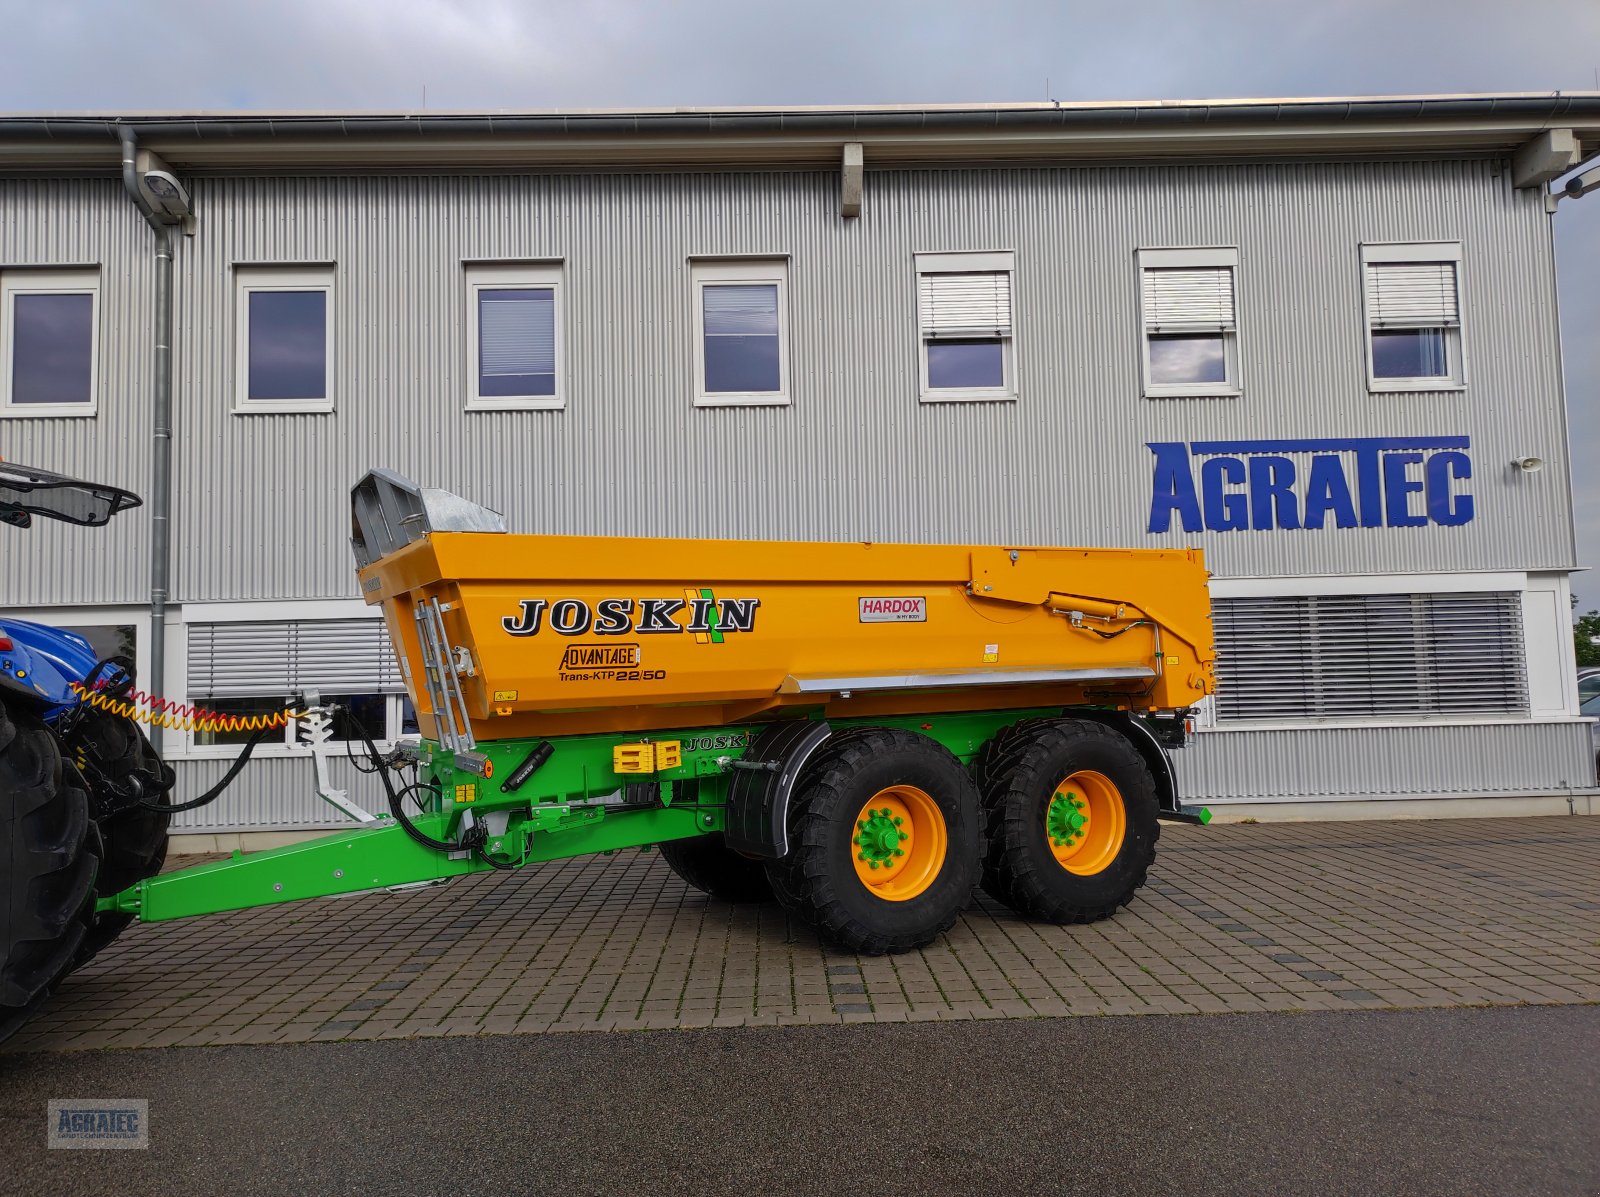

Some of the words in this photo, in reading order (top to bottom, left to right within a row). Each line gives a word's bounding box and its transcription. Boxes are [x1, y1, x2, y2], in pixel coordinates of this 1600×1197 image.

[1144, 435, 1474, 534] AGRATEC
[863, 599, 921, 613] HARDOX
[501, 598, 761, 636] JOSKIN
[558, 647, 635, 671] ADVANTAGE
[559, 671, 615, 682] Trans-KTP
[615, 670, 667, 682] 22/50
[685, 734, 757, 752] JOSKI
